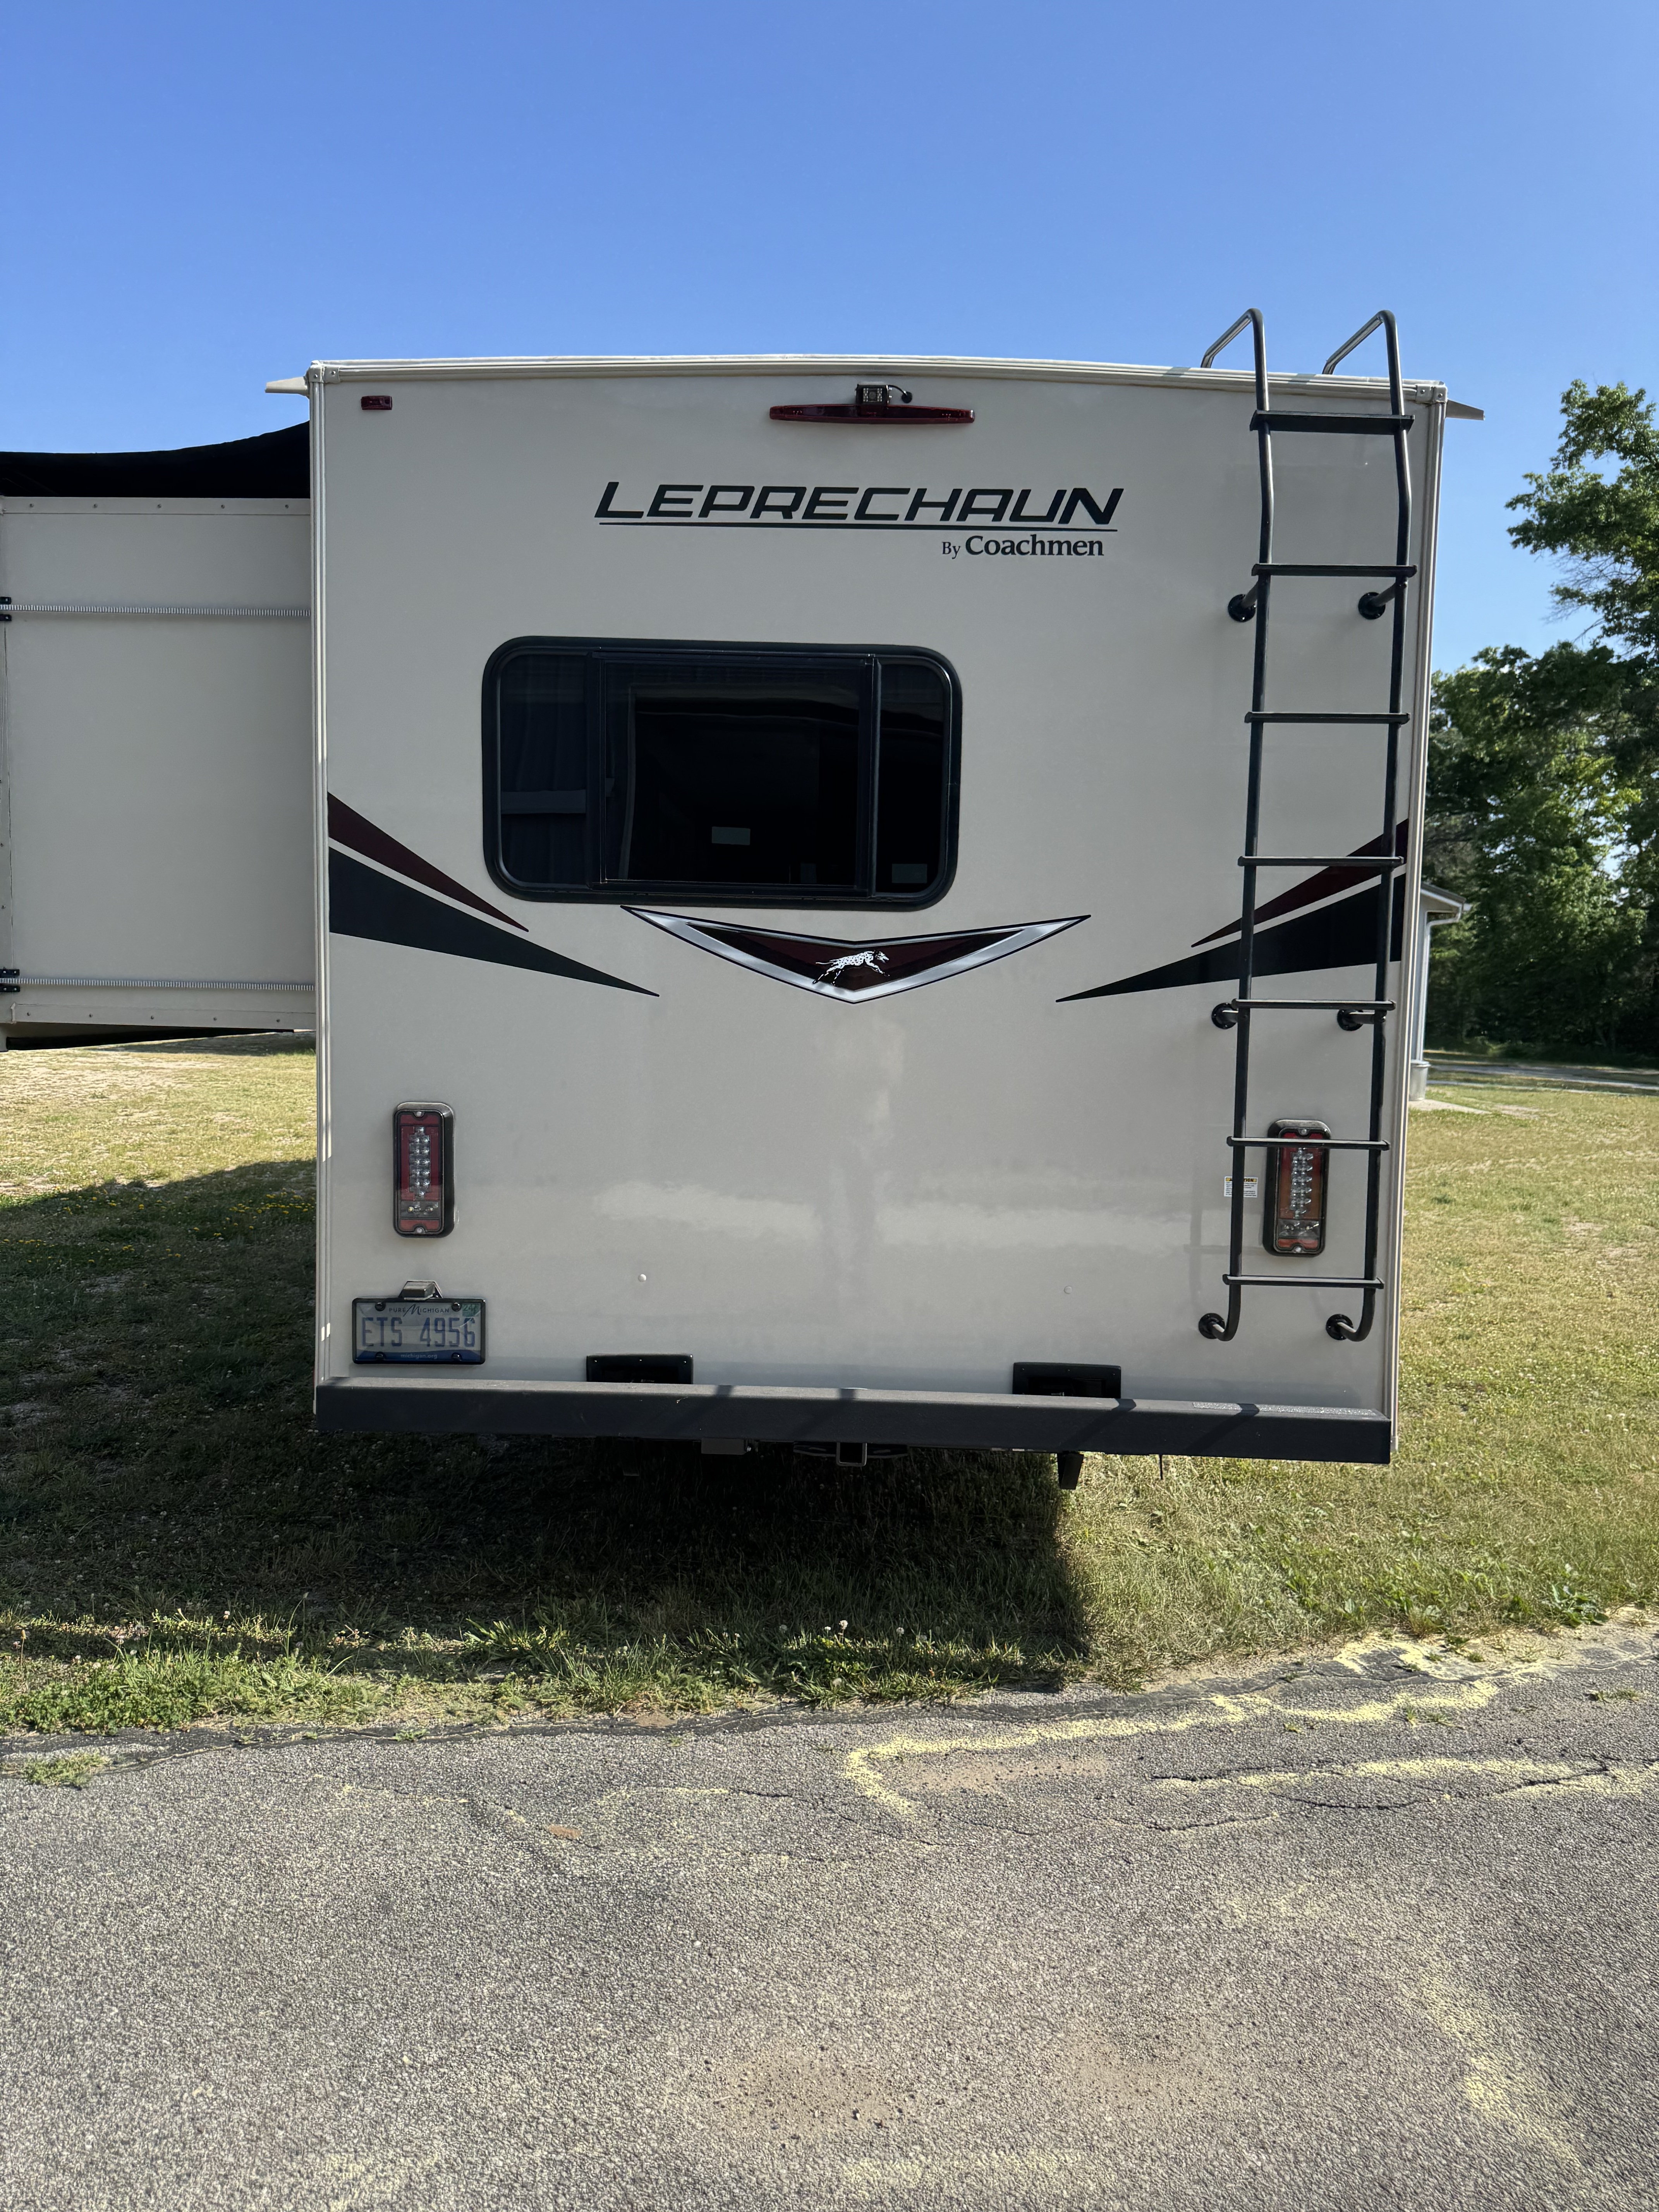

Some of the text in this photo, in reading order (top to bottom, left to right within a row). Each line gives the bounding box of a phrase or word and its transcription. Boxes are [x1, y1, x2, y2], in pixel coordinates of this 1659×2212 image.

[594, 481, 1125, 524] LEPRECHAUN
[942, 534, 1105, 560] By Coachmen
[362, 1317, 476, 1347] ETS 4956
